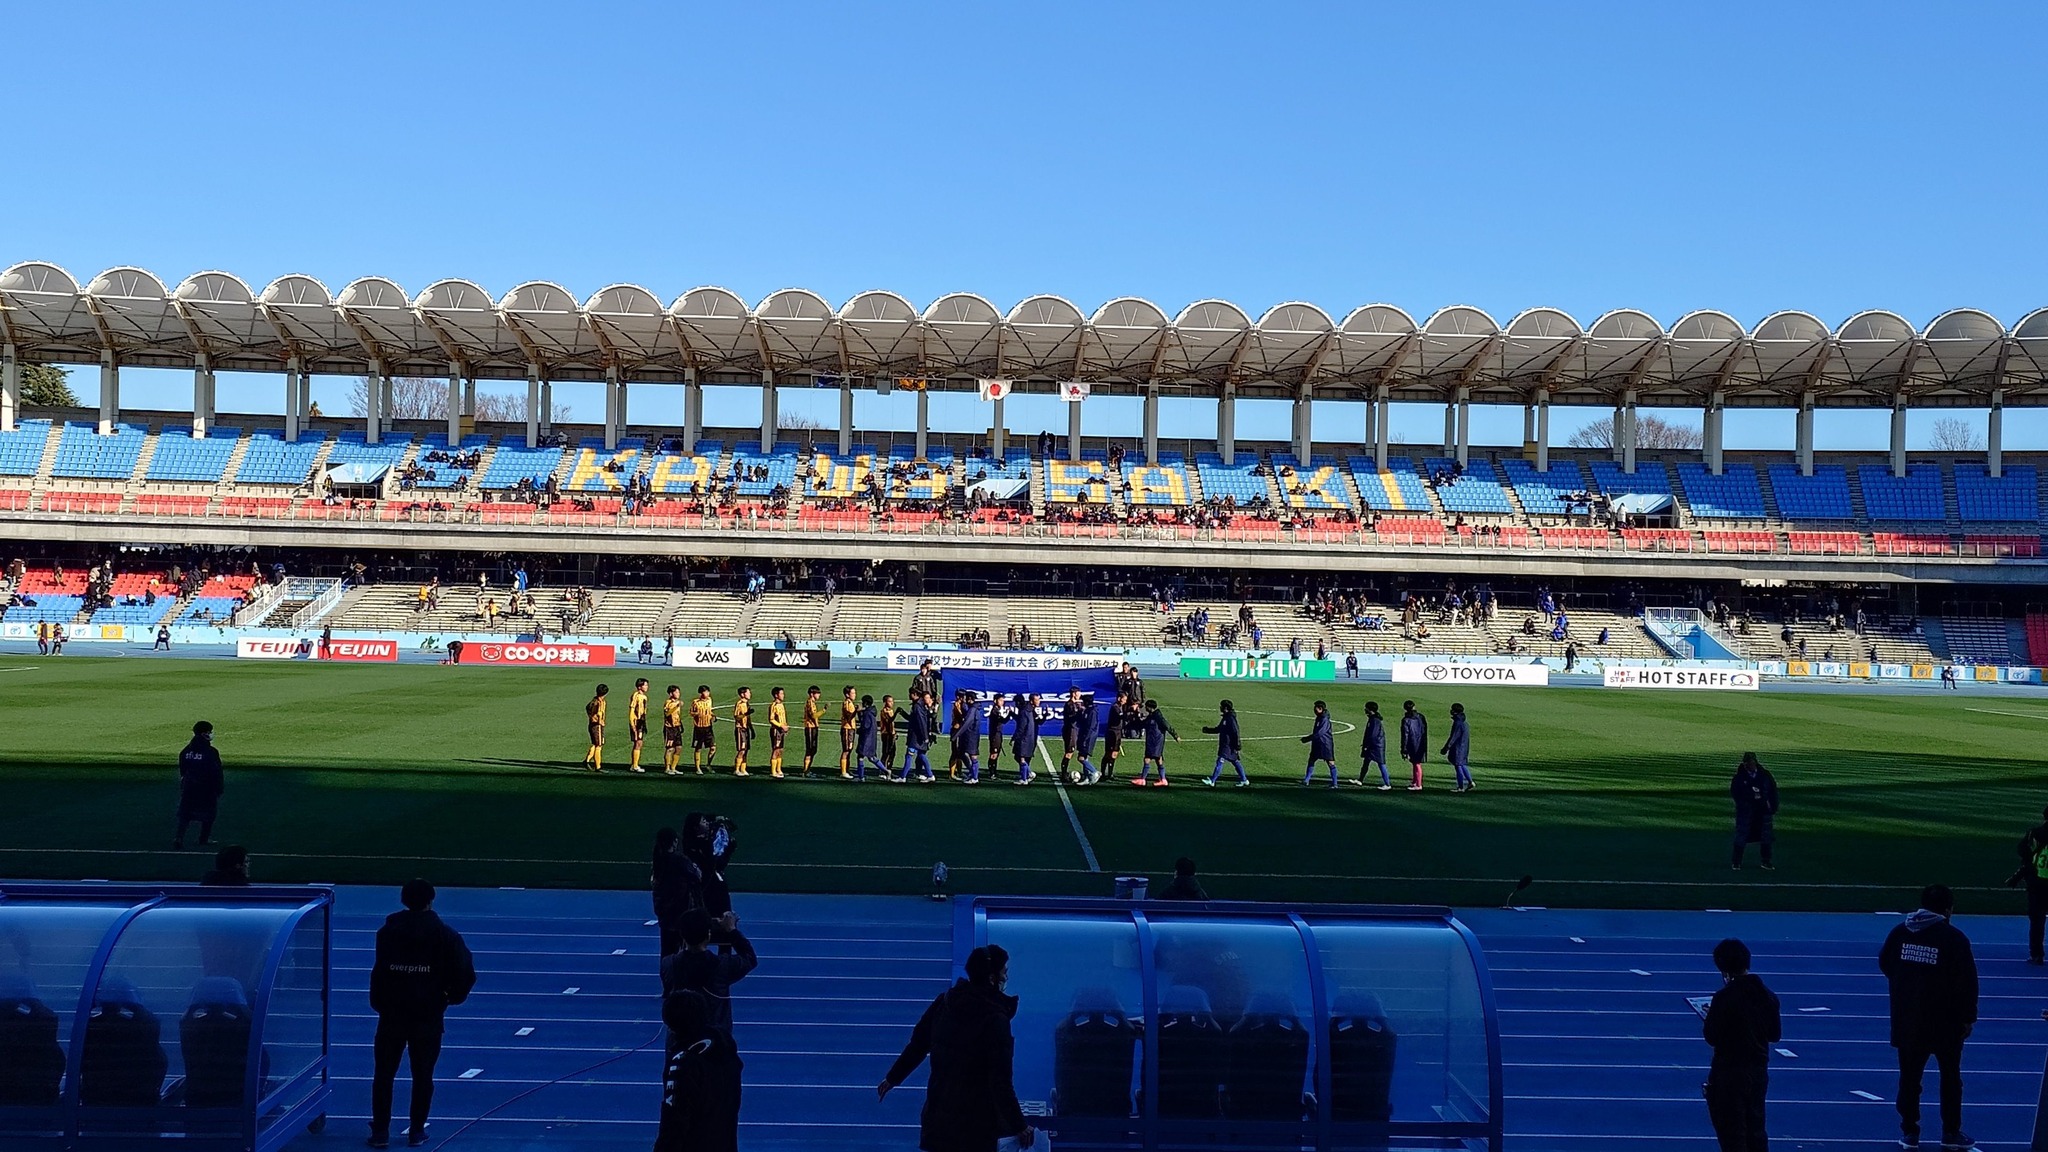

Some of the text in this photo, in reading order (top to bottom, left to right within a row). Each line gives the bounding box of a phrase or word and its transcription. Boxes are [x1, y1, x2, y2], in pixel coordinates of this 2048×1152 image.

[246, 642, 312, 655] TEIJIN
[329, 643, 391, 658] TEIJIN
[695, 651, 729, 664] SAVAS
[773, 652, 809, 666] SAVAS
[1209, 659, 1306, 679] FUJIFILM
[1451, 667, 1516, 680] TOYOTA
[1639, 671, 1728, 686] HOT STAFF
[389, 964, 431, 974] overprint
